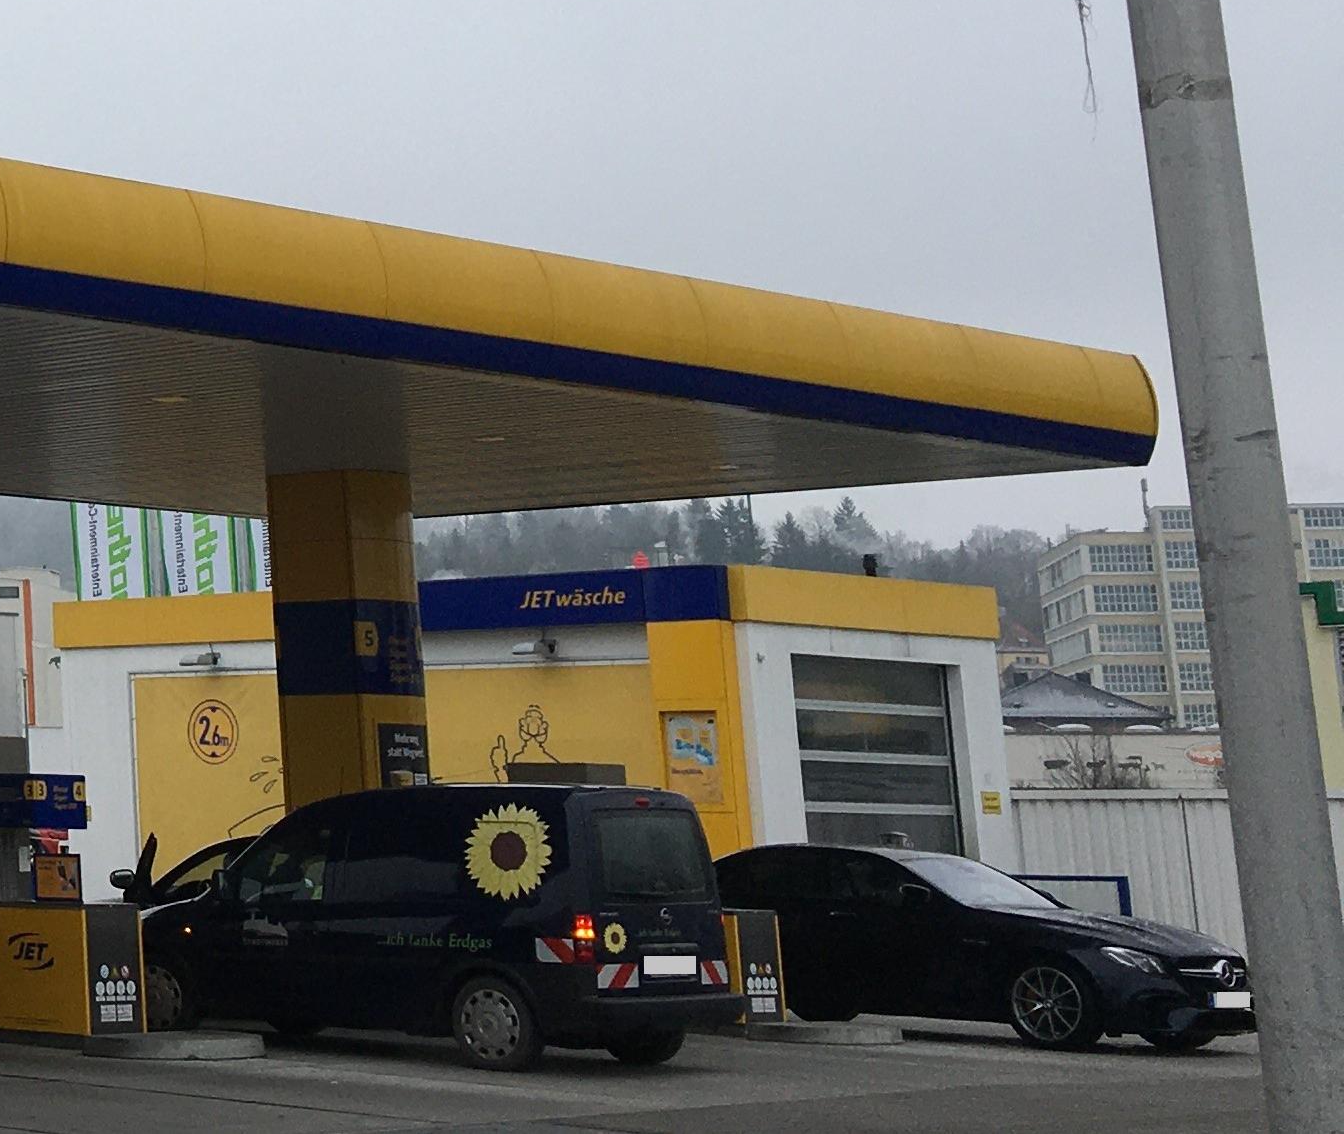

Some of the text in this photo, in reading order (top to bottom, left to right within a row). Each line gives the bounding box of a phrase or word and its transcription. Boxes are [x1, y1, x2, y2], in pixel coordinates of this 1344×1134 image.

[365, 630, 374, 647] 5
[448, 933, 493, 952] Erdgas
[12, 943, 49, 961] JET
